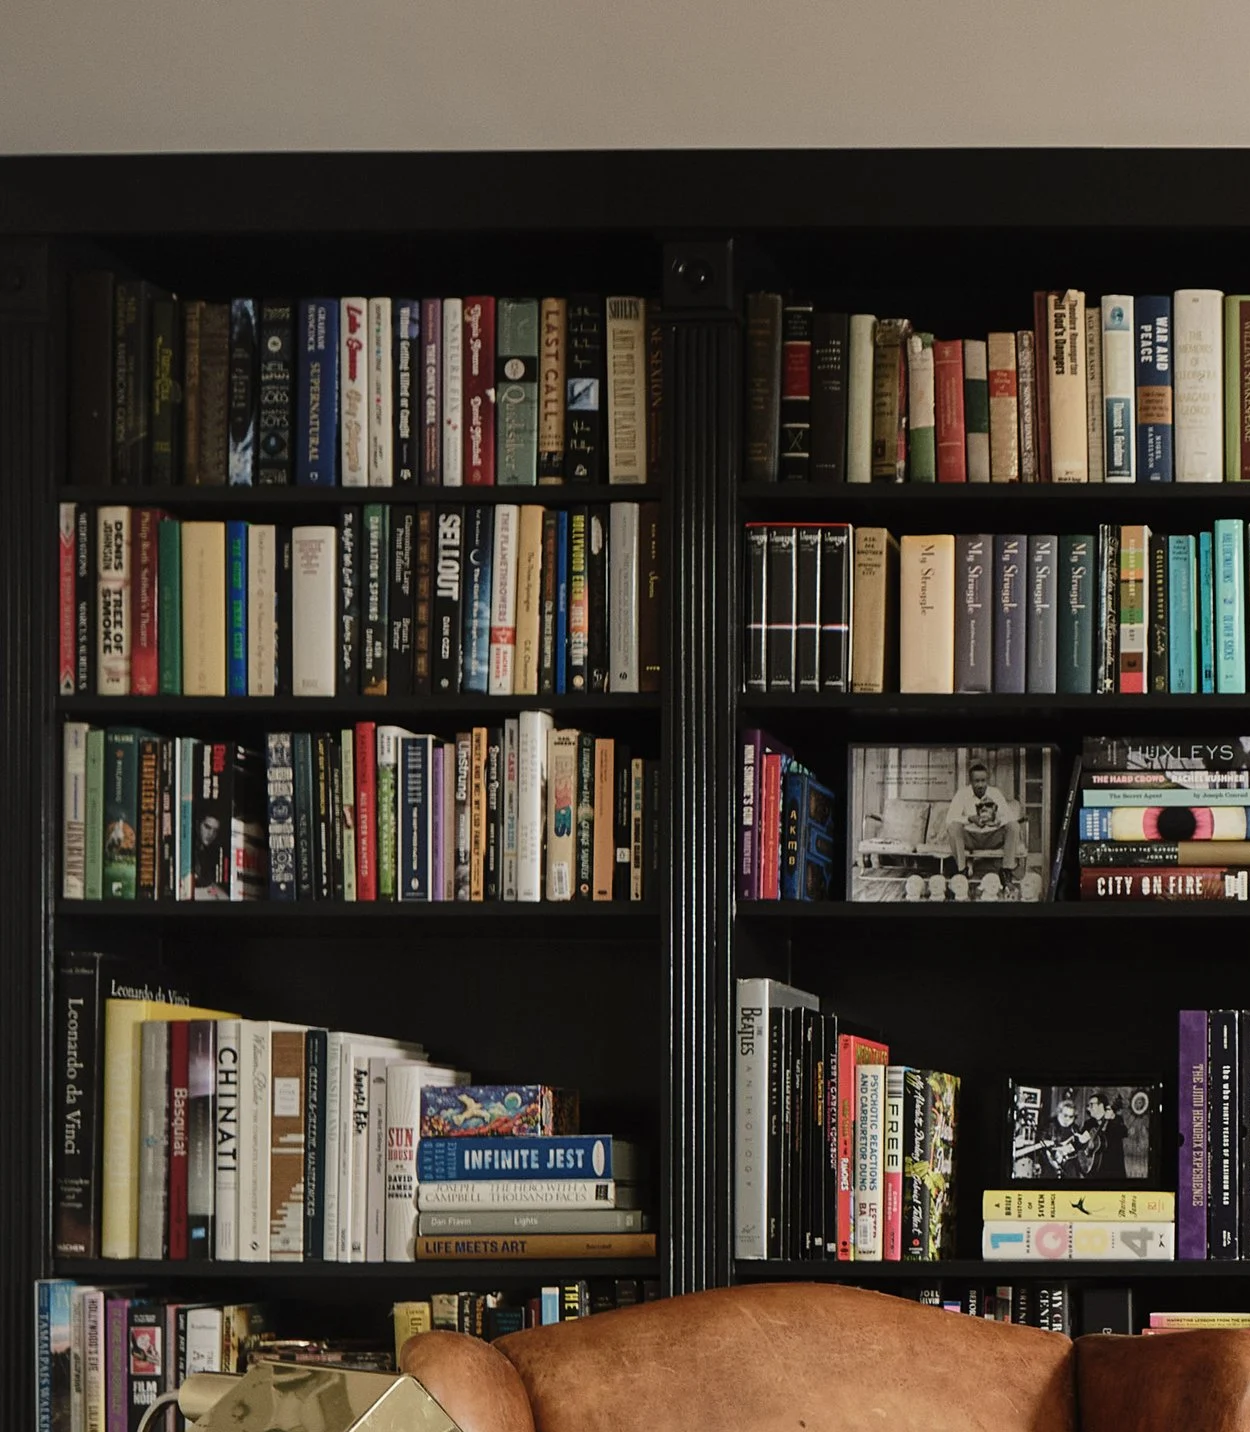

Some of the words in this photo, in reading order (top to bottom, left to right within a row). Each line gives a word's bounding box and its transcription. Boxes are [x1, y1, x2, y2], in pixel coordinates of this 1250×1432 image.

[545, 311, 560, 359] LAST
[1140, 325, 1153, 362] PEACE
[1155, 317, 1168, 341] WAR
[1155, 346, 1168, 371] AND
[309, 362, 319, 462] SUPERNATURAL
[545, 369, 560, 421] CALL
[103, 521, 112, 570] JOHNSON
[114, 521, 123, 570] DENIS
[437, 514, 460, 601] SELLOUT
[572, 515, 585, 571] HOLLYWOOD
[966, 542, 982, 561] My
[113, 589, 123, 629] TREE
[572, 575, 584, 599] EDEN
[966, 565, 982, 613] Struggle
[103, 589, 112, 654] SMOKE
[113, 634, 123, 654] OF
[457, 741, 468, 799] Unstrung
[1097, 876, 1133, 895] CITY
[1142, 876, 1162, 895] ON
[1169, 876, 1203, 895] FIRE
[64, 998, 83, 1078] Leonardo
[738, 1007, 762, 1055] BEATLES
[65, 1083, 81, 1105] da
[859, 1073, 868, 1092] AND
[1193, 1064, 1203, 1082] THE
[1193, 1084, 1203, 1105] JIMI
[171, 1089, 187, 1156] Basquiat
[218, 1048, 236, 1172] CHINATI
[869, 1074, 877, 1129] PSYCHOTIC
[63, 1110, 80, 1155] Vinci
[859, 1095, 868, 1158] CARBURETOR
[887, 1104, 898, 1167] FREE
[1193, 1108, 1203, 1146] HENDRIX
[464, 1149, 539, 1170] INFINITE
[547, 1149, 584, 1169] JEST
[859, 1162, 868, 1191] DUNG
[869, 1133, 877, 1191] REACTIONS
[1193, 1150, 1203, 1206] EXPERIENCE
[426, 1241, 451, 1254] LIFE
[455, 1241, 498, 1254] MEETS
[502, 1240, 526, 1253] ART
